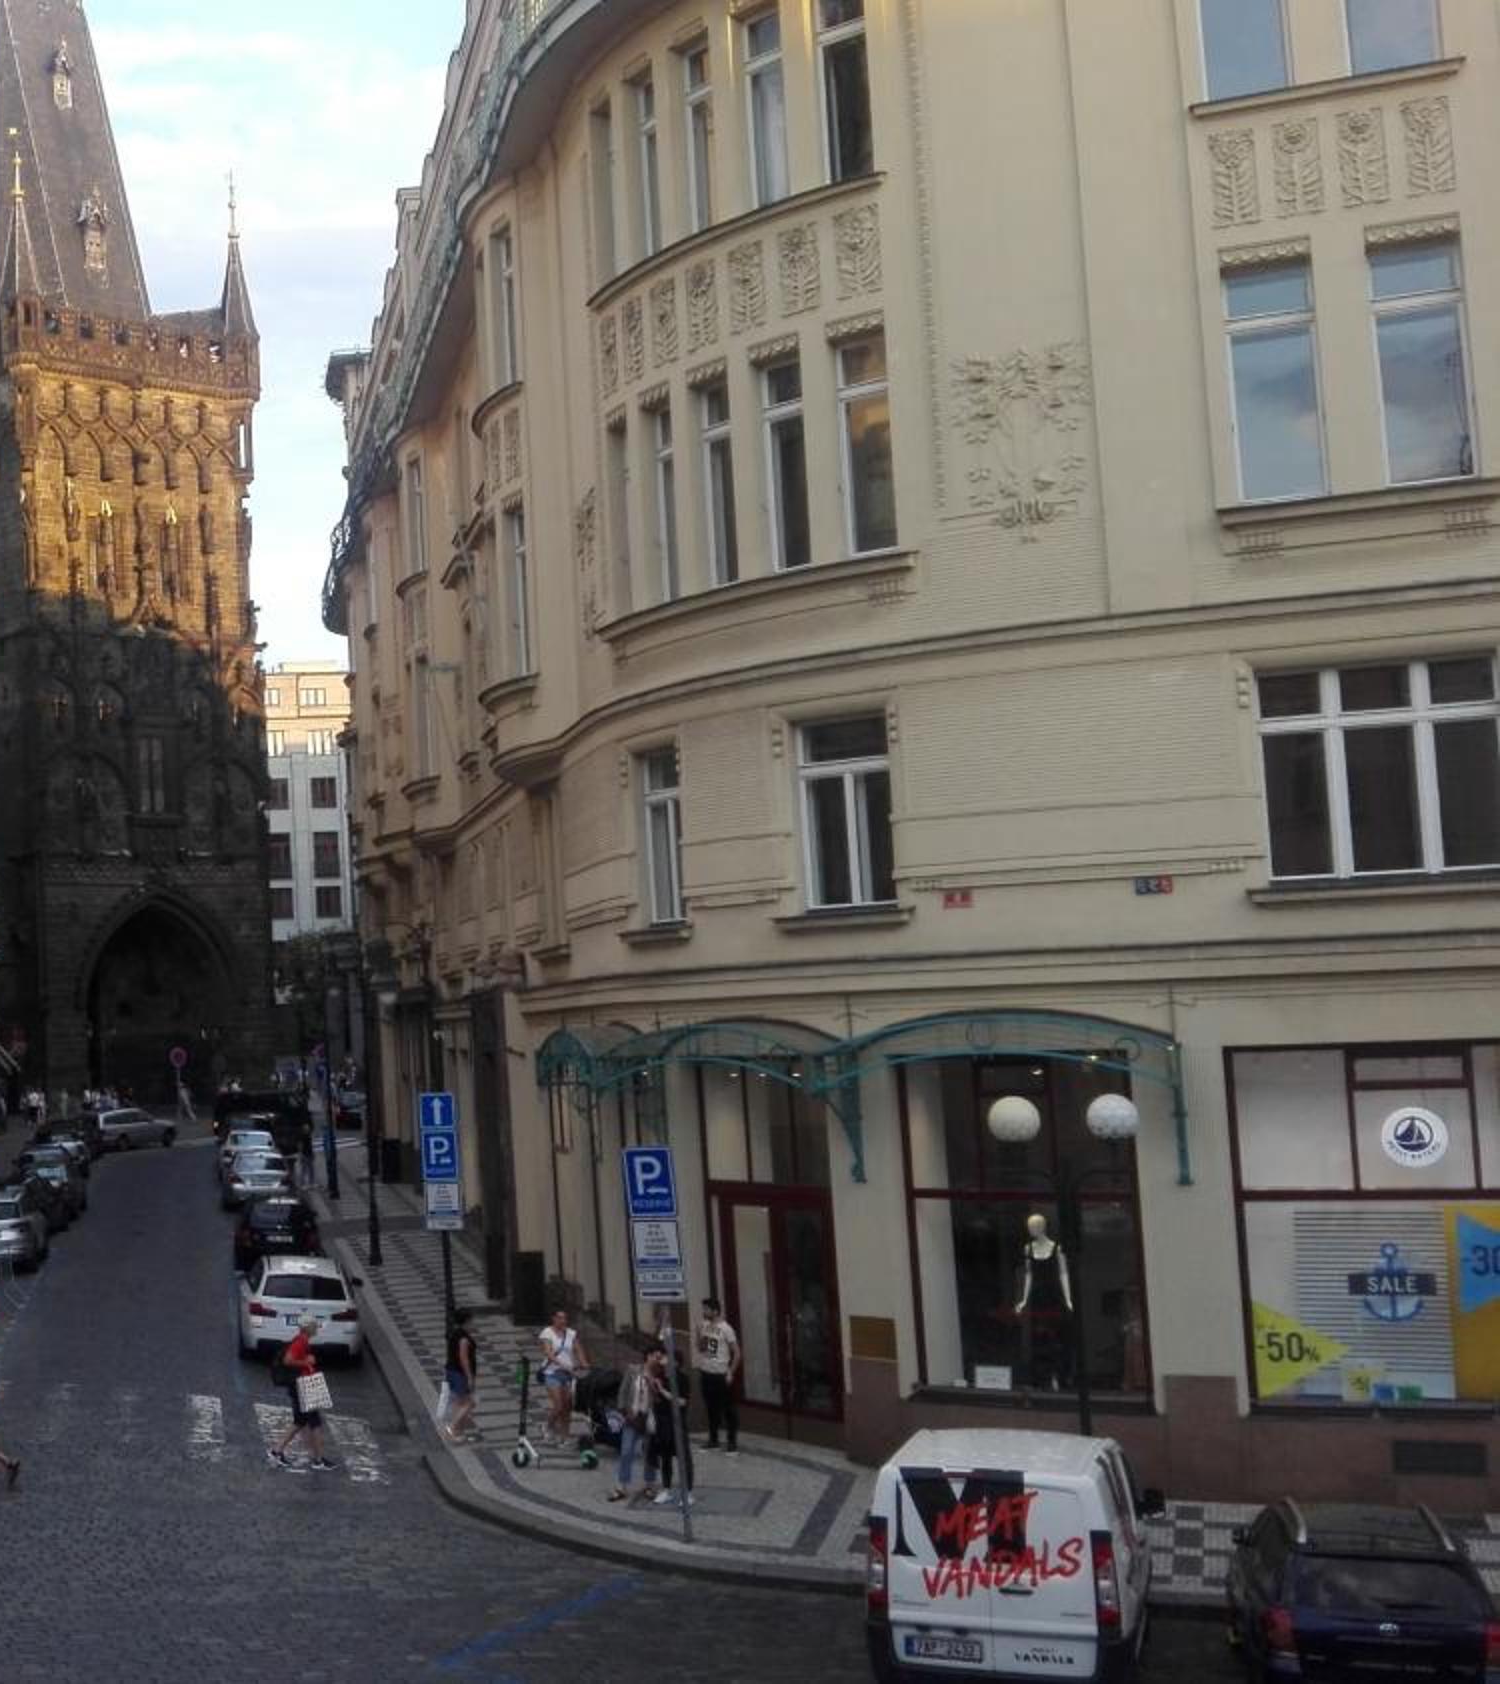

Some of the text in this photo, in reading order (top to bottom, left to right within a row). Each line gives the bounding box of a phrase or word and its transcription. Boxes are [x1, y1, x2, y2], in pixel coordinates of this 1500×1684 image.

[429, 1136, 449, 1164] P
[633, 1156, 661, 1195] P
[1366, 1276, 1419, 1293] SALE
[933, 1488, 1039, 1551] MEAT
[922, 1536, 1086, 1599] VANDALS
